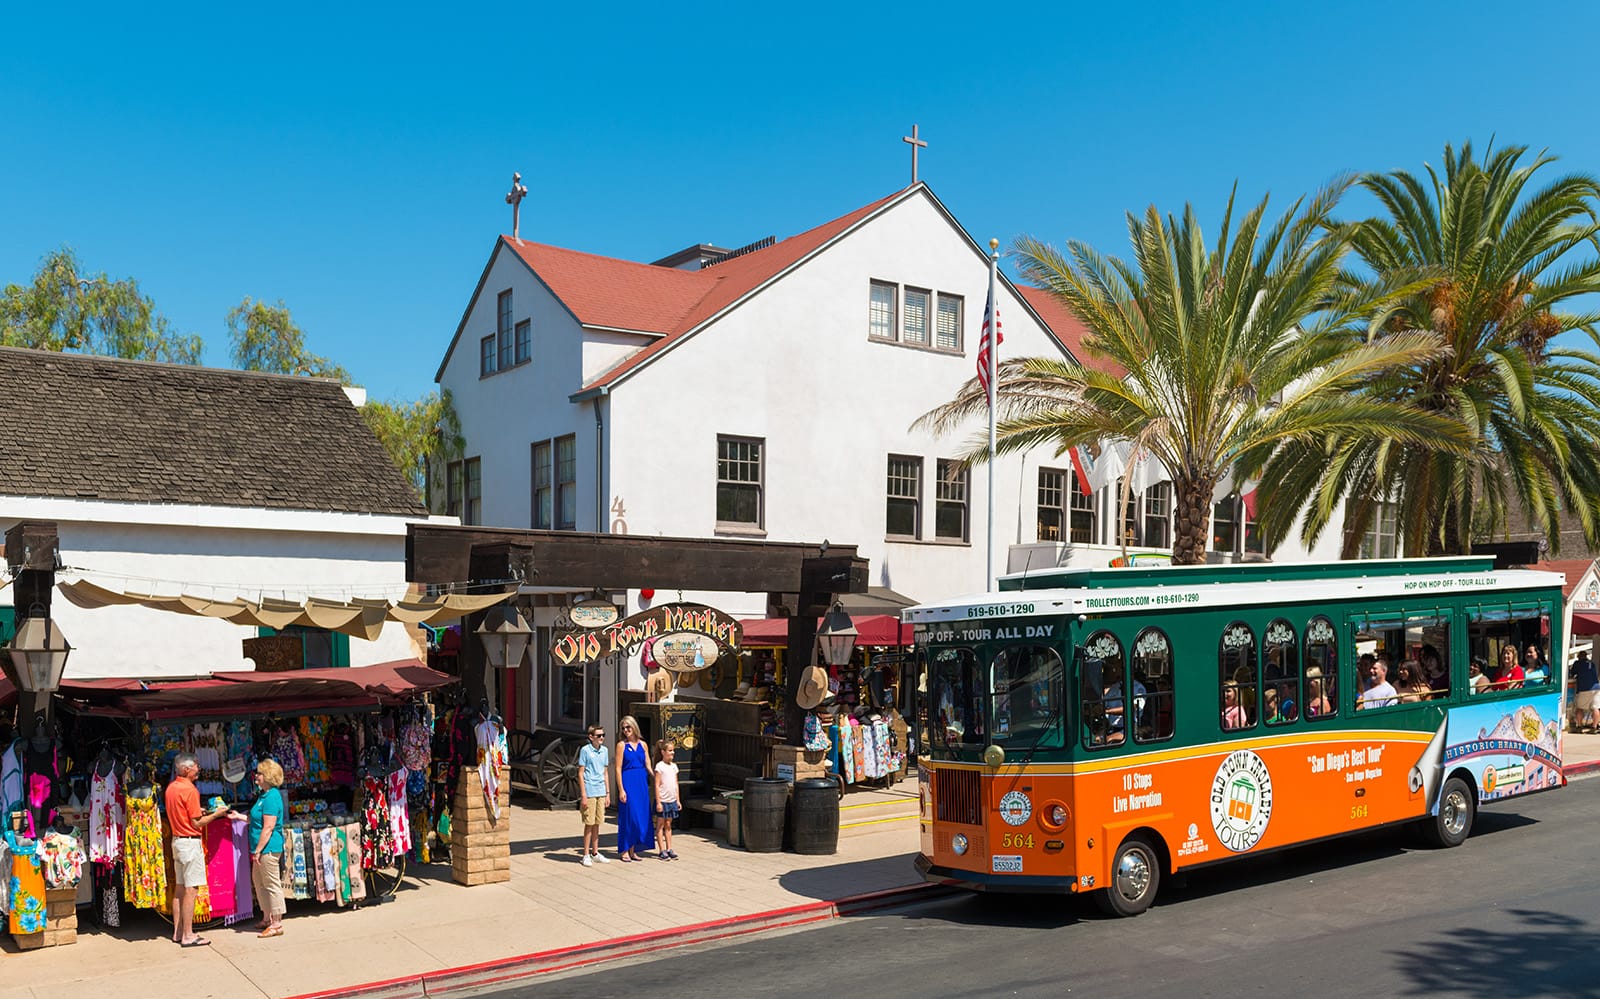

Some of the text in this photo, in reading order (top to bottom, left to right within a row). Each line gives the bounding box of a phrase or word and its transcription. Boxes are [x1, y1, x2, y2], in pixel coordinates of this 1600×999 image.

[1404, 582, 1417, 590] HOP
[1418, 581, 1428, 589] ON
[1428, 580, 1441, 588] HOP
[1458, 578, 1474, 586] TOUR
[1486, 577, 1498, 585] DAY
[1086, 593, 1200, 608] TROLLEYTOURS.COM 619-610-1290
[967, 603, 1035, 618] 619-610-1290
[554, 606, 737, 665] Old Town Market
[936, 631, 954, 642] OFF
[962, 628, 992, 641] TOUR
[995, 626, 1022, 639] ALL
[1025, 625, 1054, 638] DAY
[1351, 748, 1366, 767] Best
[1445, 741, 1495, 759] HISTORIC
[1498, 740, 1522, 750] HEART
[1123, 773, 1152, 791] 10 Stops
[1212, 752, 1271, 818] OLD TOWN TROLLEY
[1487, 773, 1493, 789] F
[1113, 791, 1162, 813] Live Narration
[1350, 804, 1368, 819] 564
[1215, 813, 1259, 850] TOURS
[1002, 832, 1035, 849] 564
